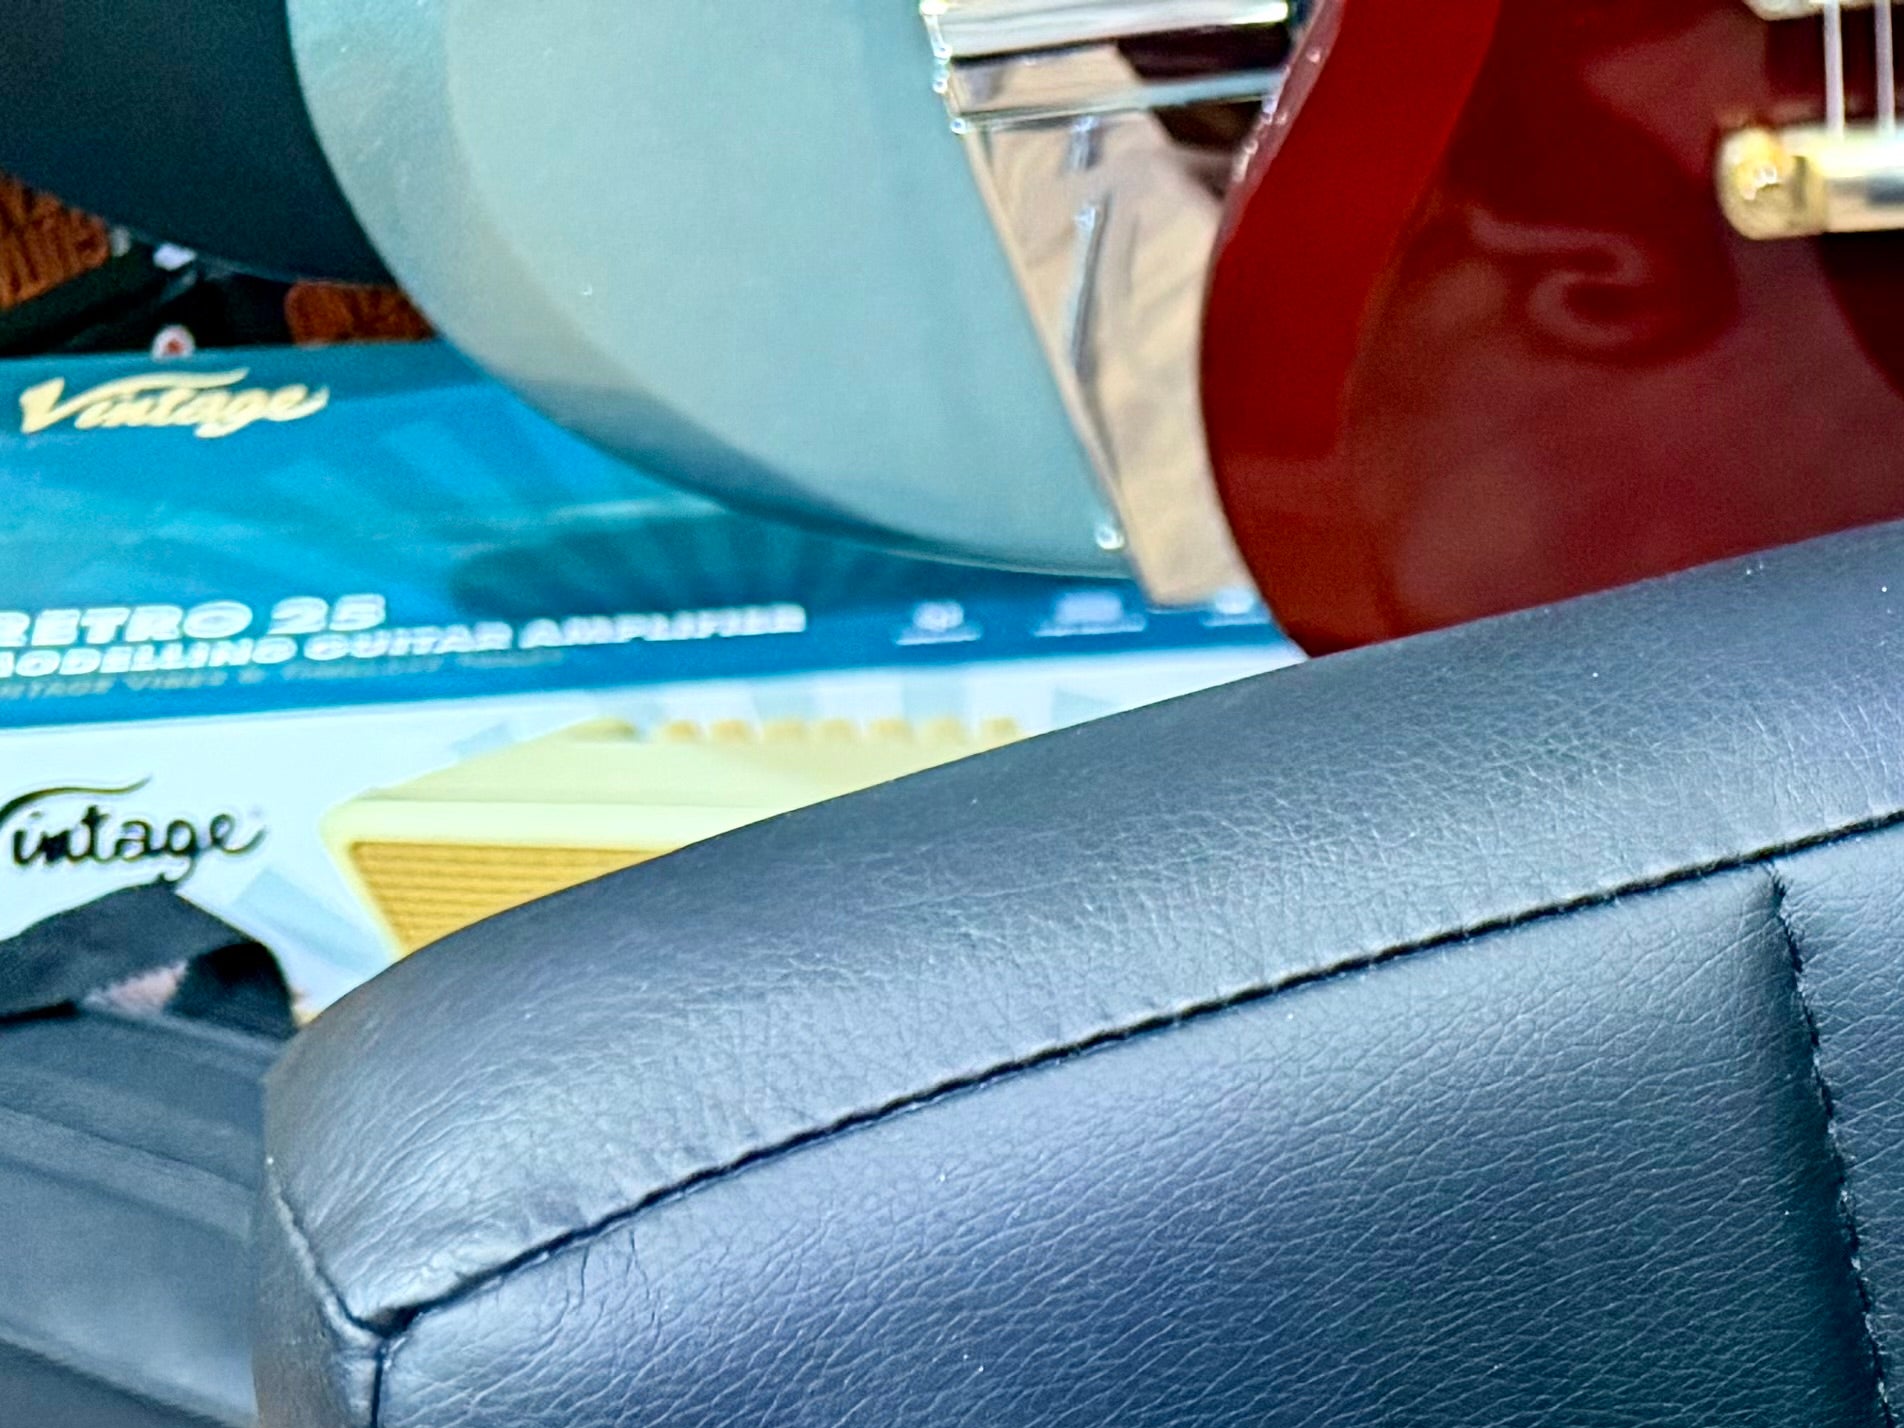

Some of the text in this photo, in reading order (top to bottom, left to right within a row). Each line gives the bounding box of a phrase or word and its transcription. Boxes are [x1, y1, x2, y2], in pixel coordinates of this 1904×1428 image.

[20, 367, 330, 438] Vintage
[266, 593, 386, 636] 25
[0, 636, 299, 679] ODELLING
[303, 620, 514, 661] GUITAR
